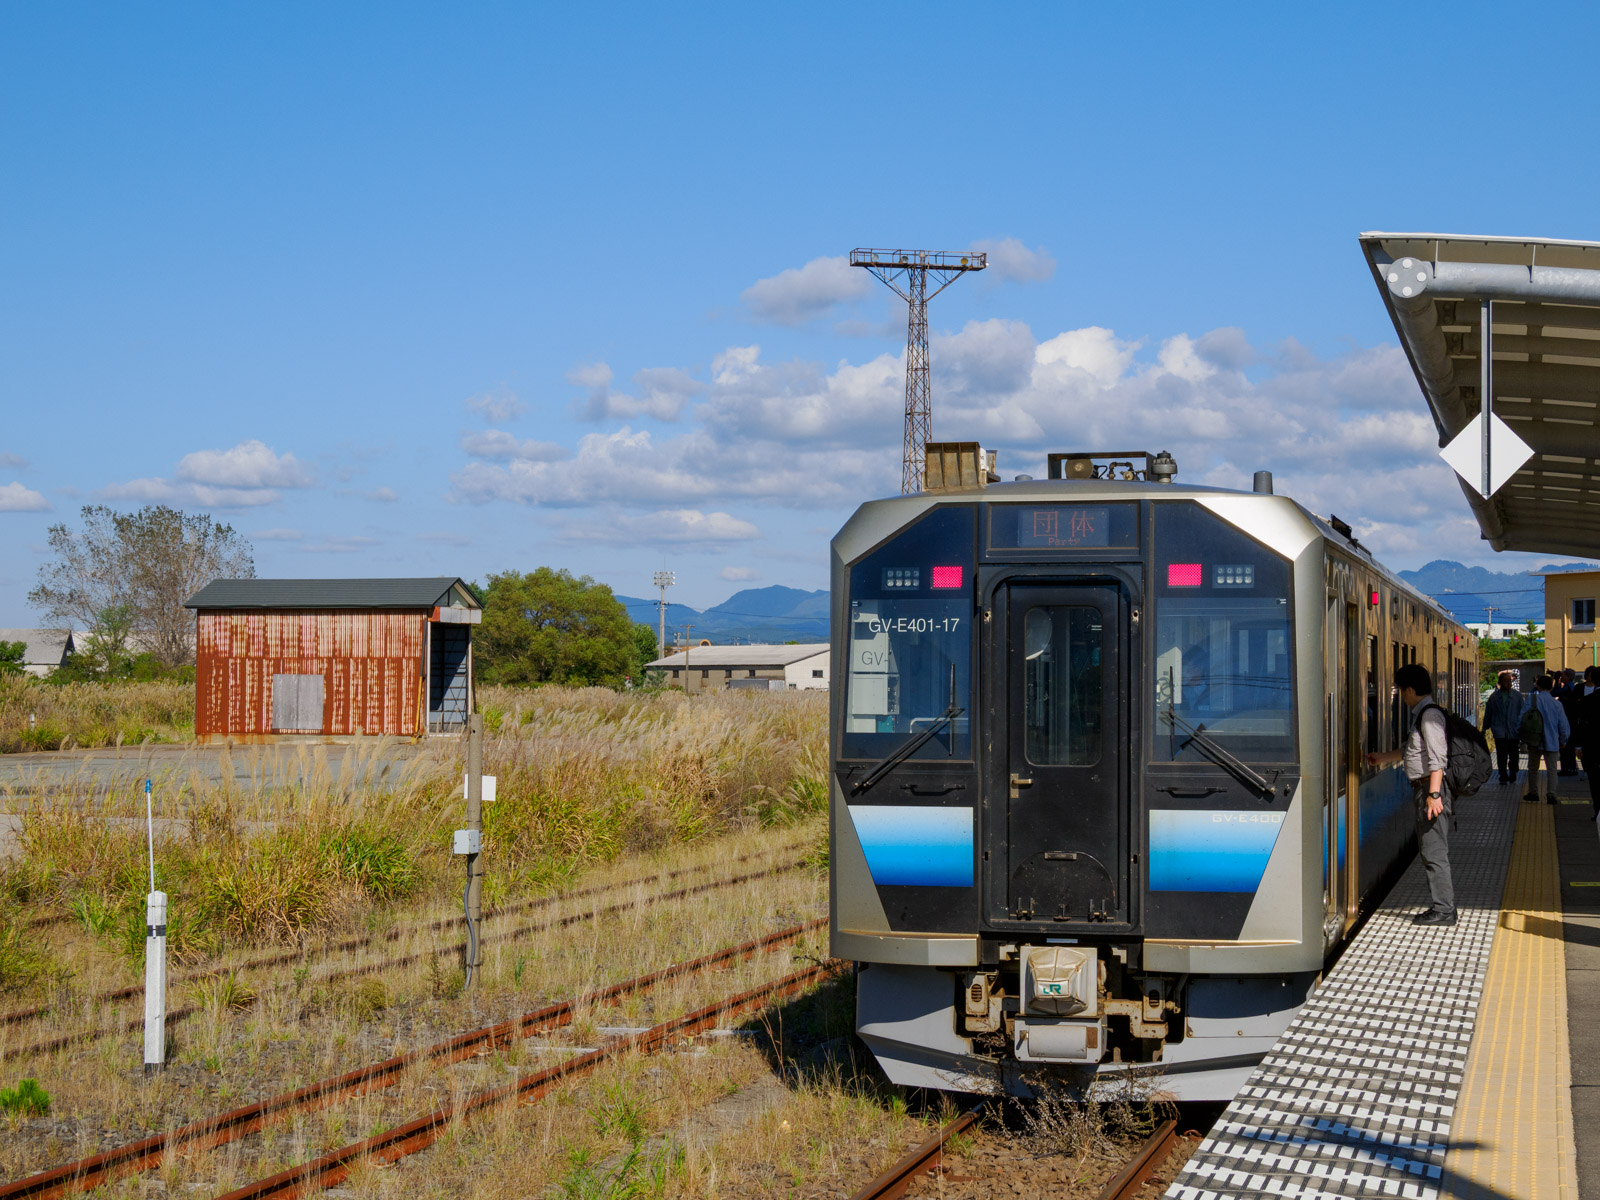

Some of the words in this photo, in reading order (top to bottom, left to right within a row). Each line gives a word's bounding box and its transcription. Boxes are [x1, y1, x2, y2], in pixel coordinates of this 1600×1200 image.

[1034, 511, 1095, 537] 団体
[868, 618, 960, 632] GV-E401-17
[1212, 813, 1281, 823] GV-E400
[1043, 984, 1062, 995] JR
